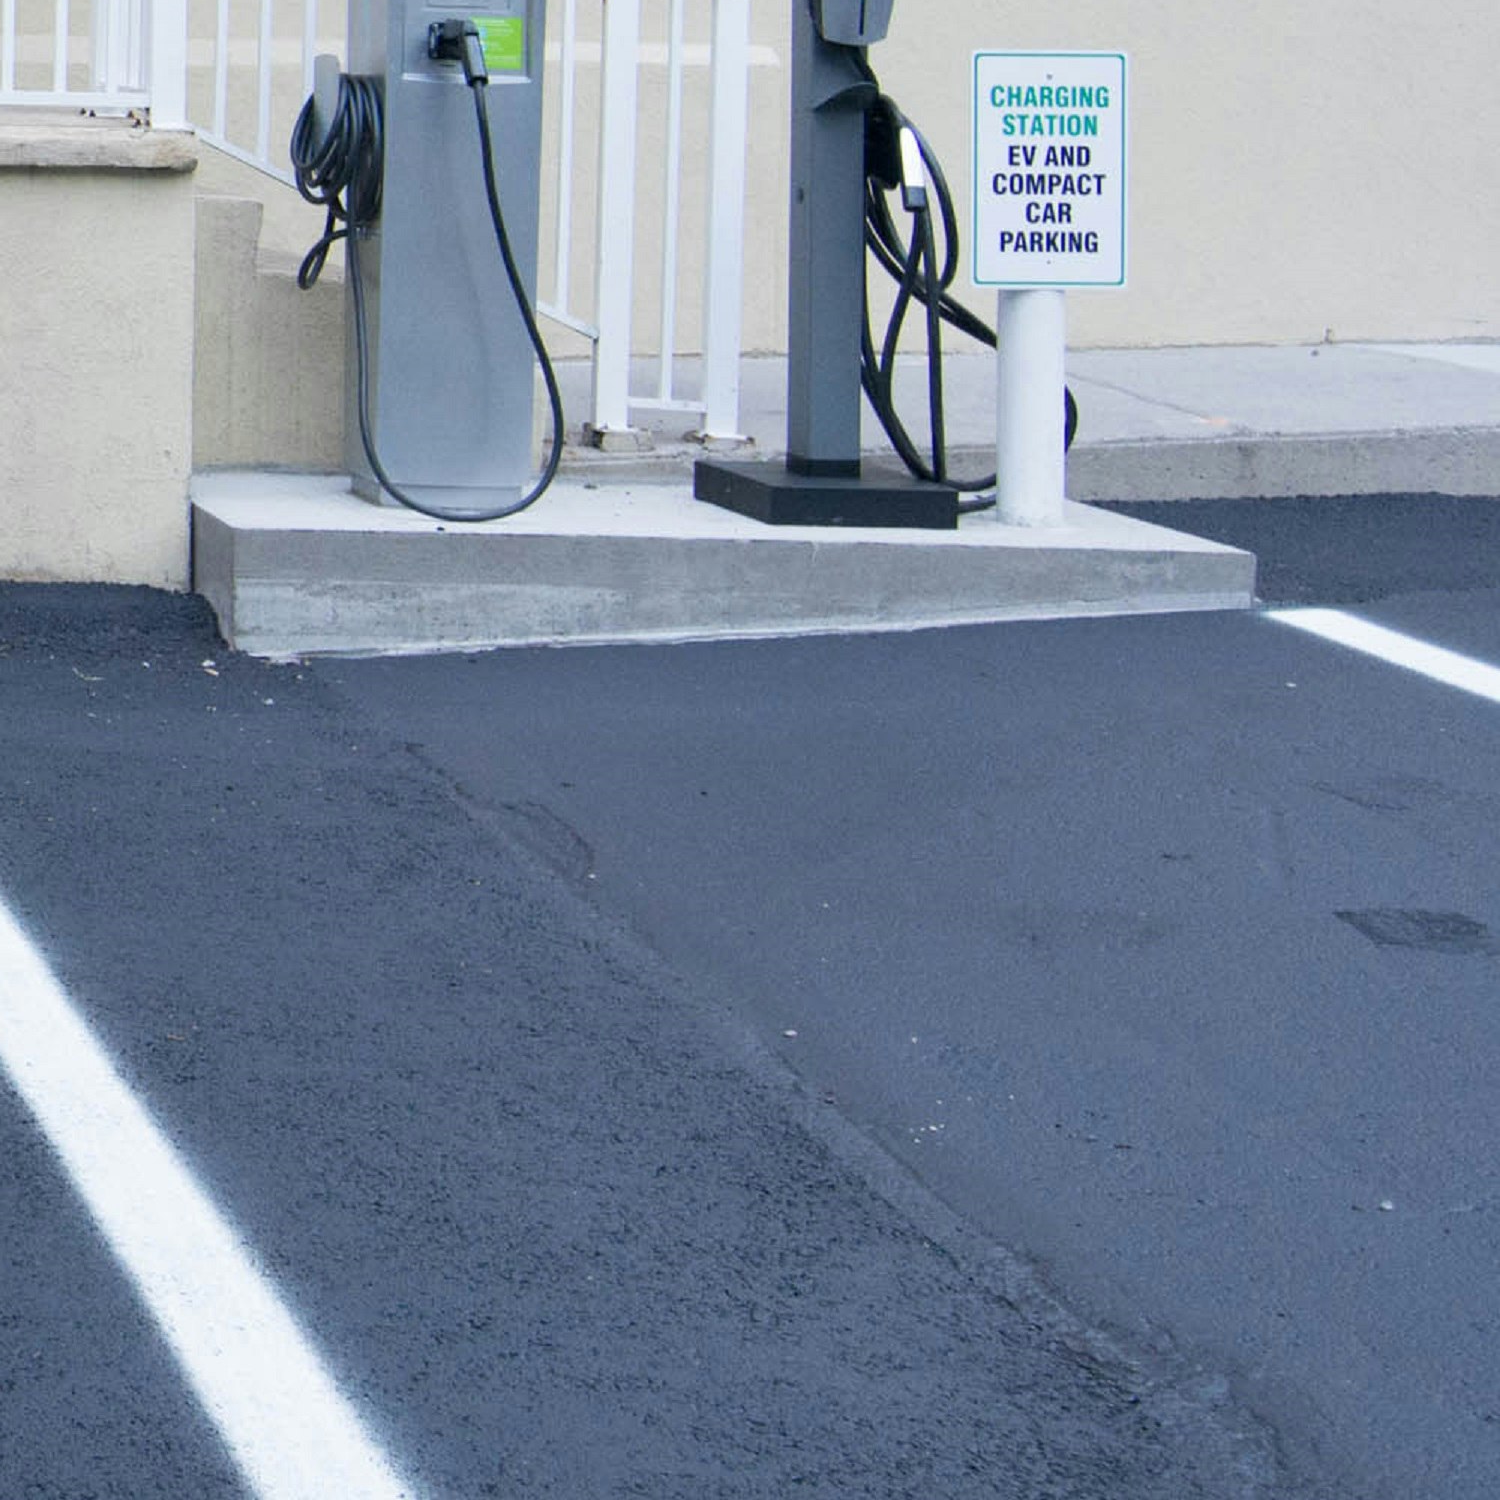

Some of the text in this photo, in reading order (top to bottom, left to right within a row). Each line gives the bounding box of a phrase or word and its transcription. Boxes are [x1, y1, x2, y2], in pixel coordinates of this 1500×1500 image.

[990, 85, 1110, 109] CHARGING
[1002, 113, 1098, 137] STATION
[1008, 145, 1091, 168] EV AND
[992, 172, 1106, 196] COMPACT
[1025, 201, 1072, 224] CAR
[999, 230, 1099, 254] PARKING
